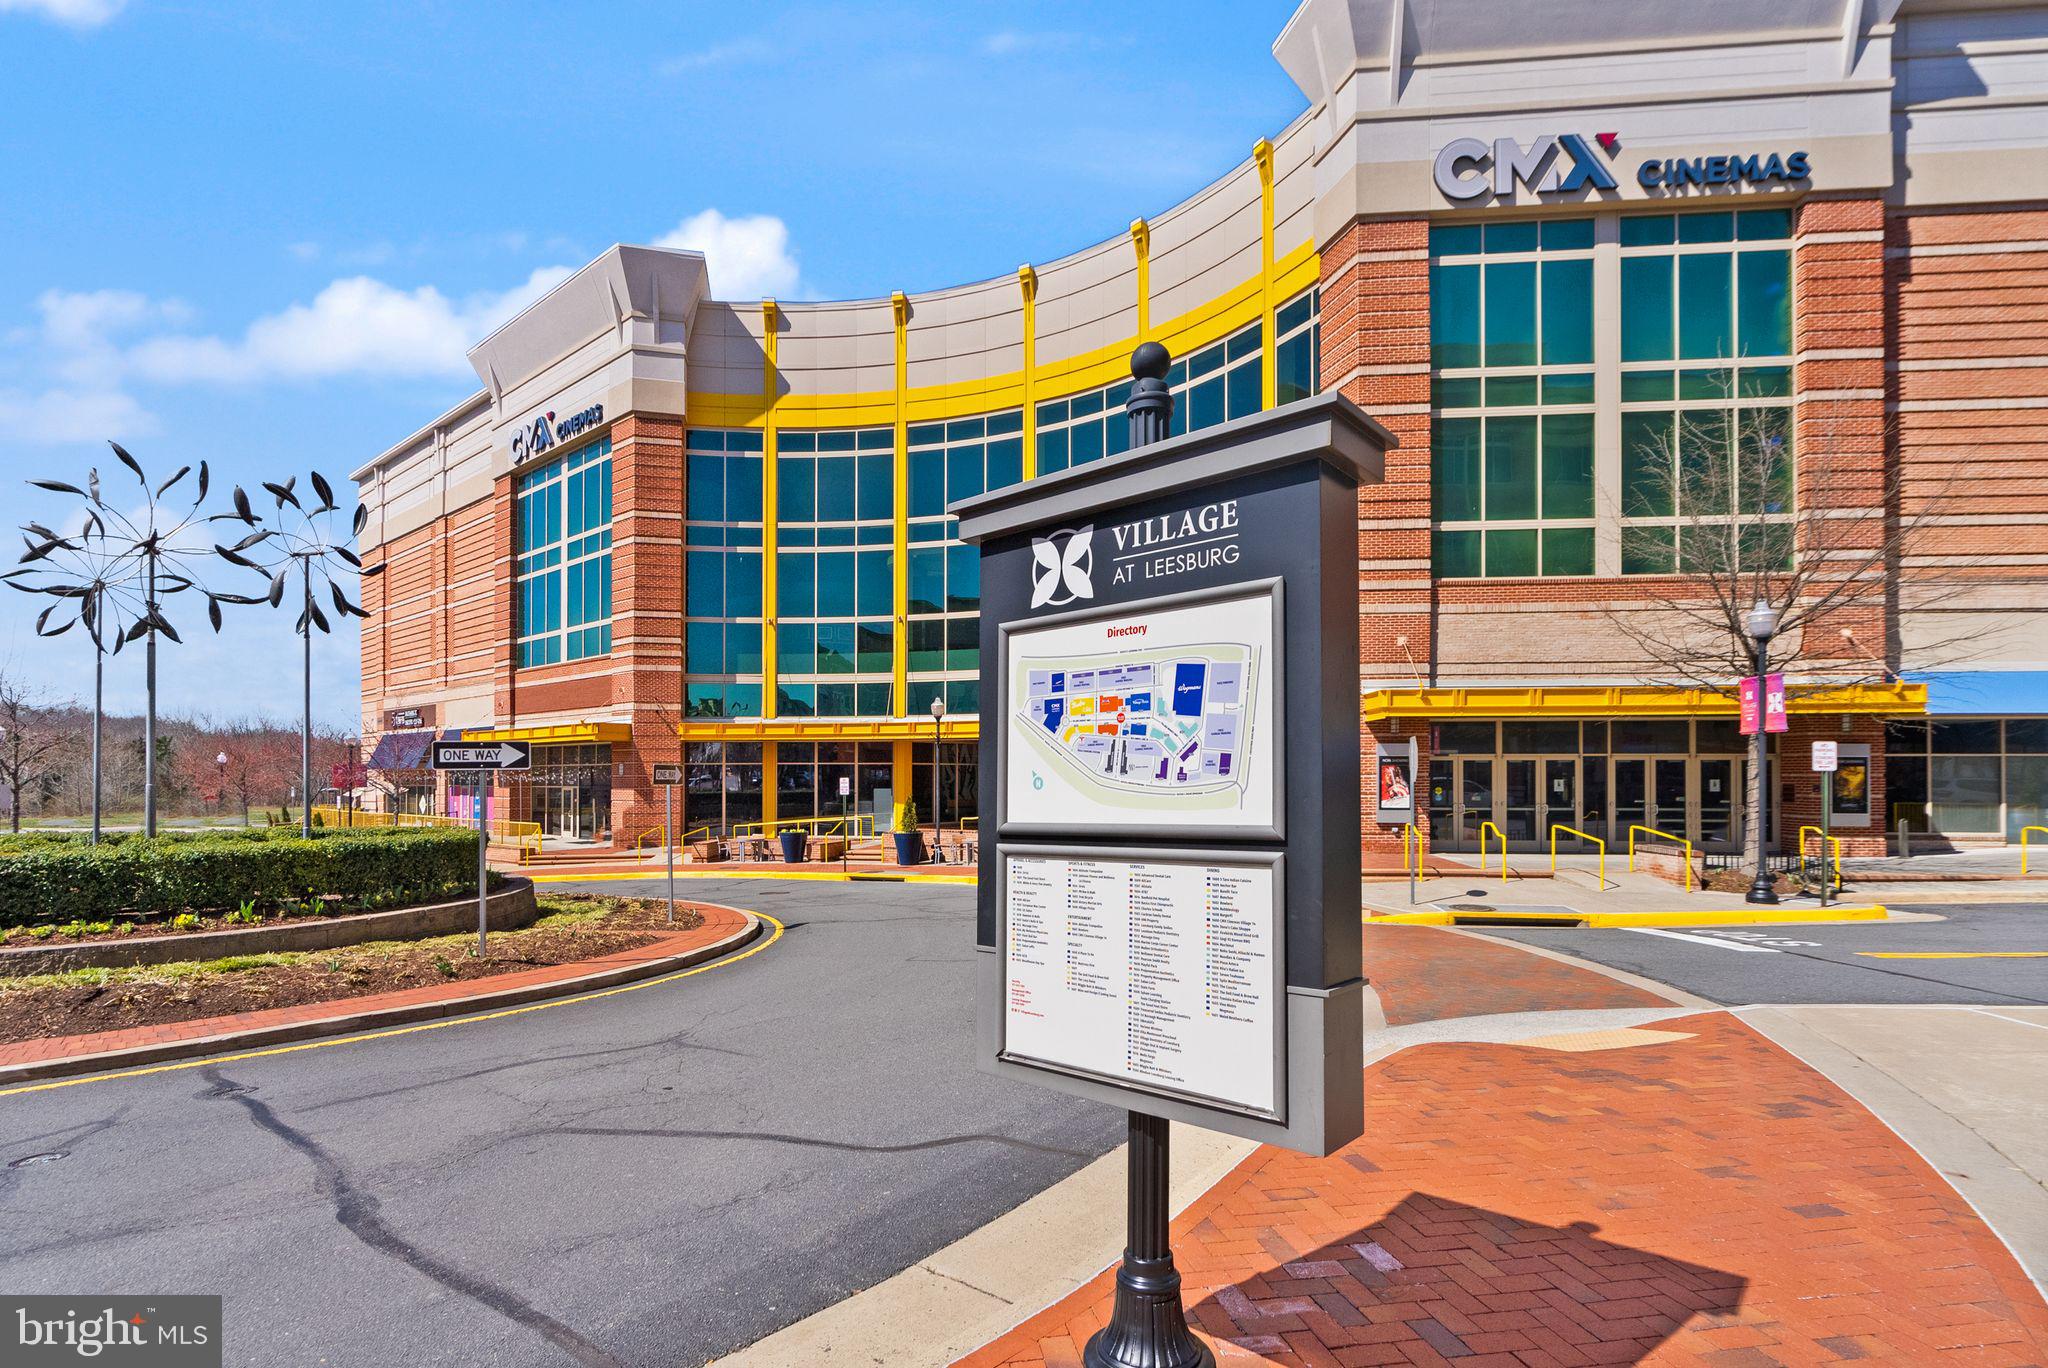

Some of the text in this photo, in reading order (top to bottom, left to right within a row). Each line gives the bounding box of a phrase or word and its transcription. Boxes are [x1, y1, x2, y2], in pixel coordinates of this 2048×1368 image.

[1434, 131, 1811, 199] CMX CINEMAS
[509, 403, 604, 465] CMX CINEMAS
[1112, 499, 1239, 551] VILLAGE
[1113, 544, 1240, 585] AT LEESBURG
[1107, 623, 1148, 638] Directory
[443, 749, 501, 761] ONE WAY
[656, 769, 677, 779] ONE WAY
